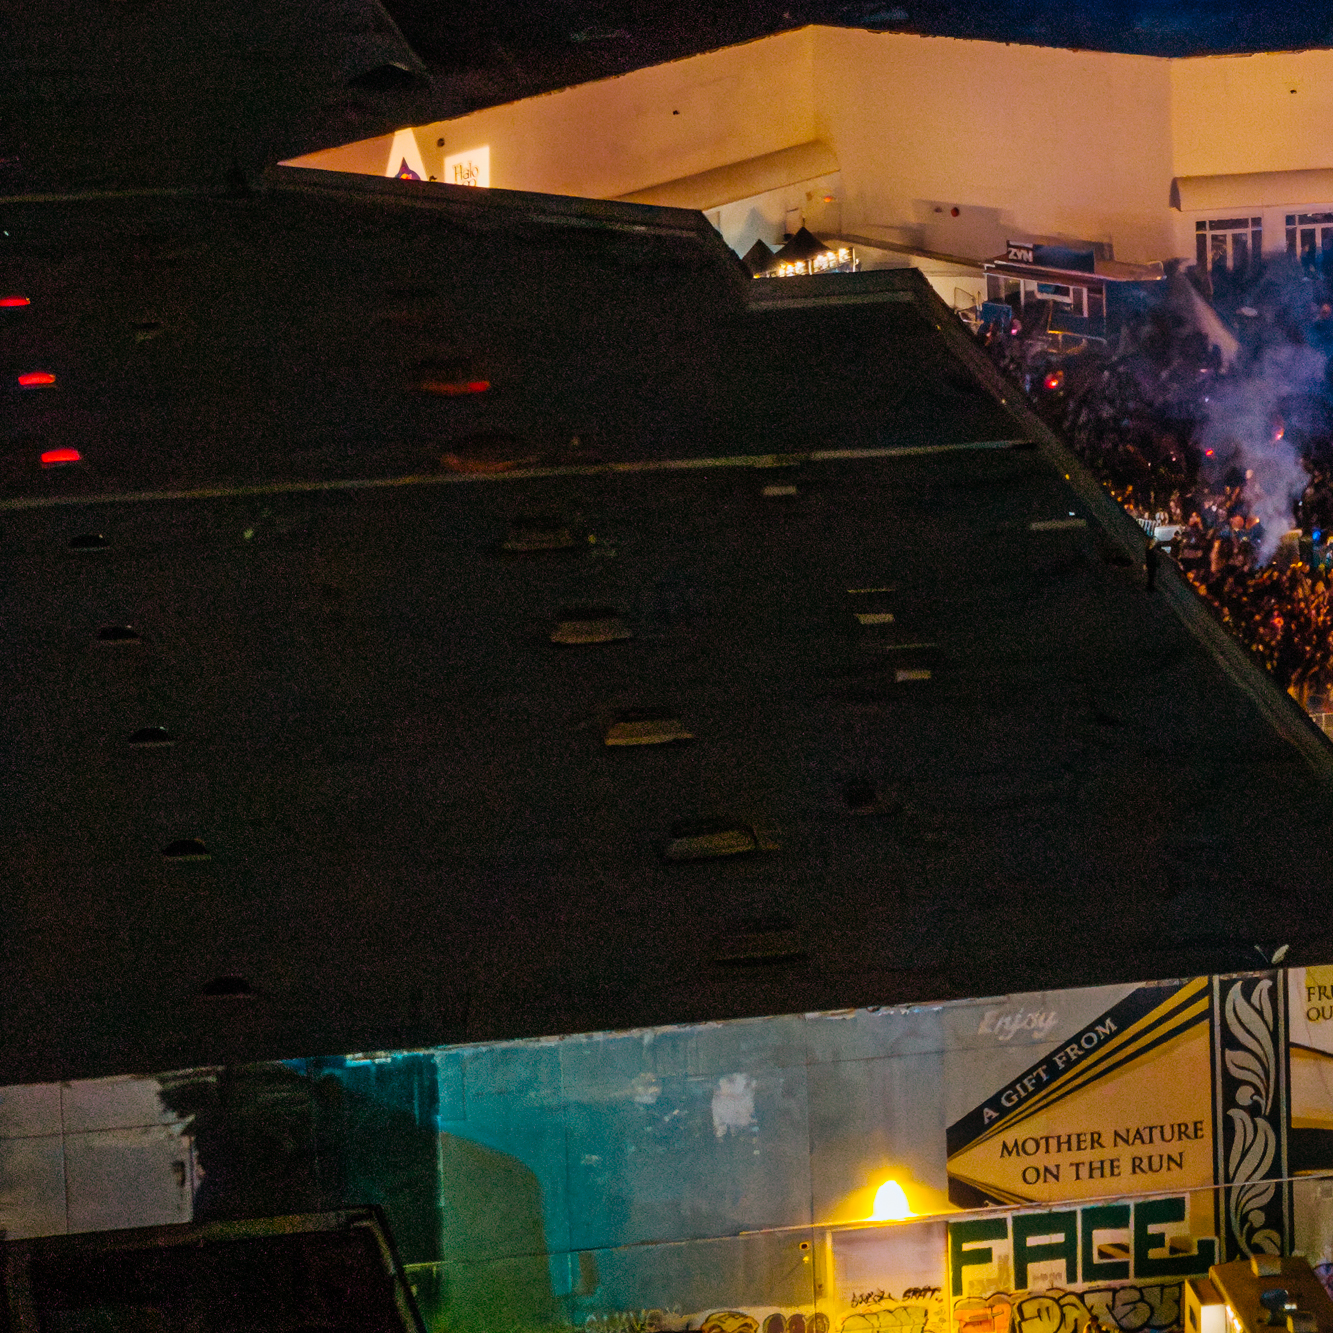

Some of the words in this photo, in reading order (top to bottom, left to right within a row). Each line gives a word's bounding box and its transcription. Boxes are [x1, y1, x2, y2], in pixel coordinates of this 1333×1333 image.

[452, 160, 479, 182] Halo
[1008, 248, 1033, 263] ZYN
[978, 1007, 1057, 1040] Enjoy
[982, 1106, 999, 1125] A
[1001, 1065, 1051, 1107] GIFT
[1053, 1018, 1118, 1070] FROM
[999, 1131, 1107, 1159] MOTHER
[1113, 1120, 1205, 1149] NATURE
[1022, 1164, 1061, 1185] ON
[1069, 1160, 1122, 1181] THE
[1130, 1151, 1185, 1175] RUN
[950, 1196, 1219, 1297] FACE
